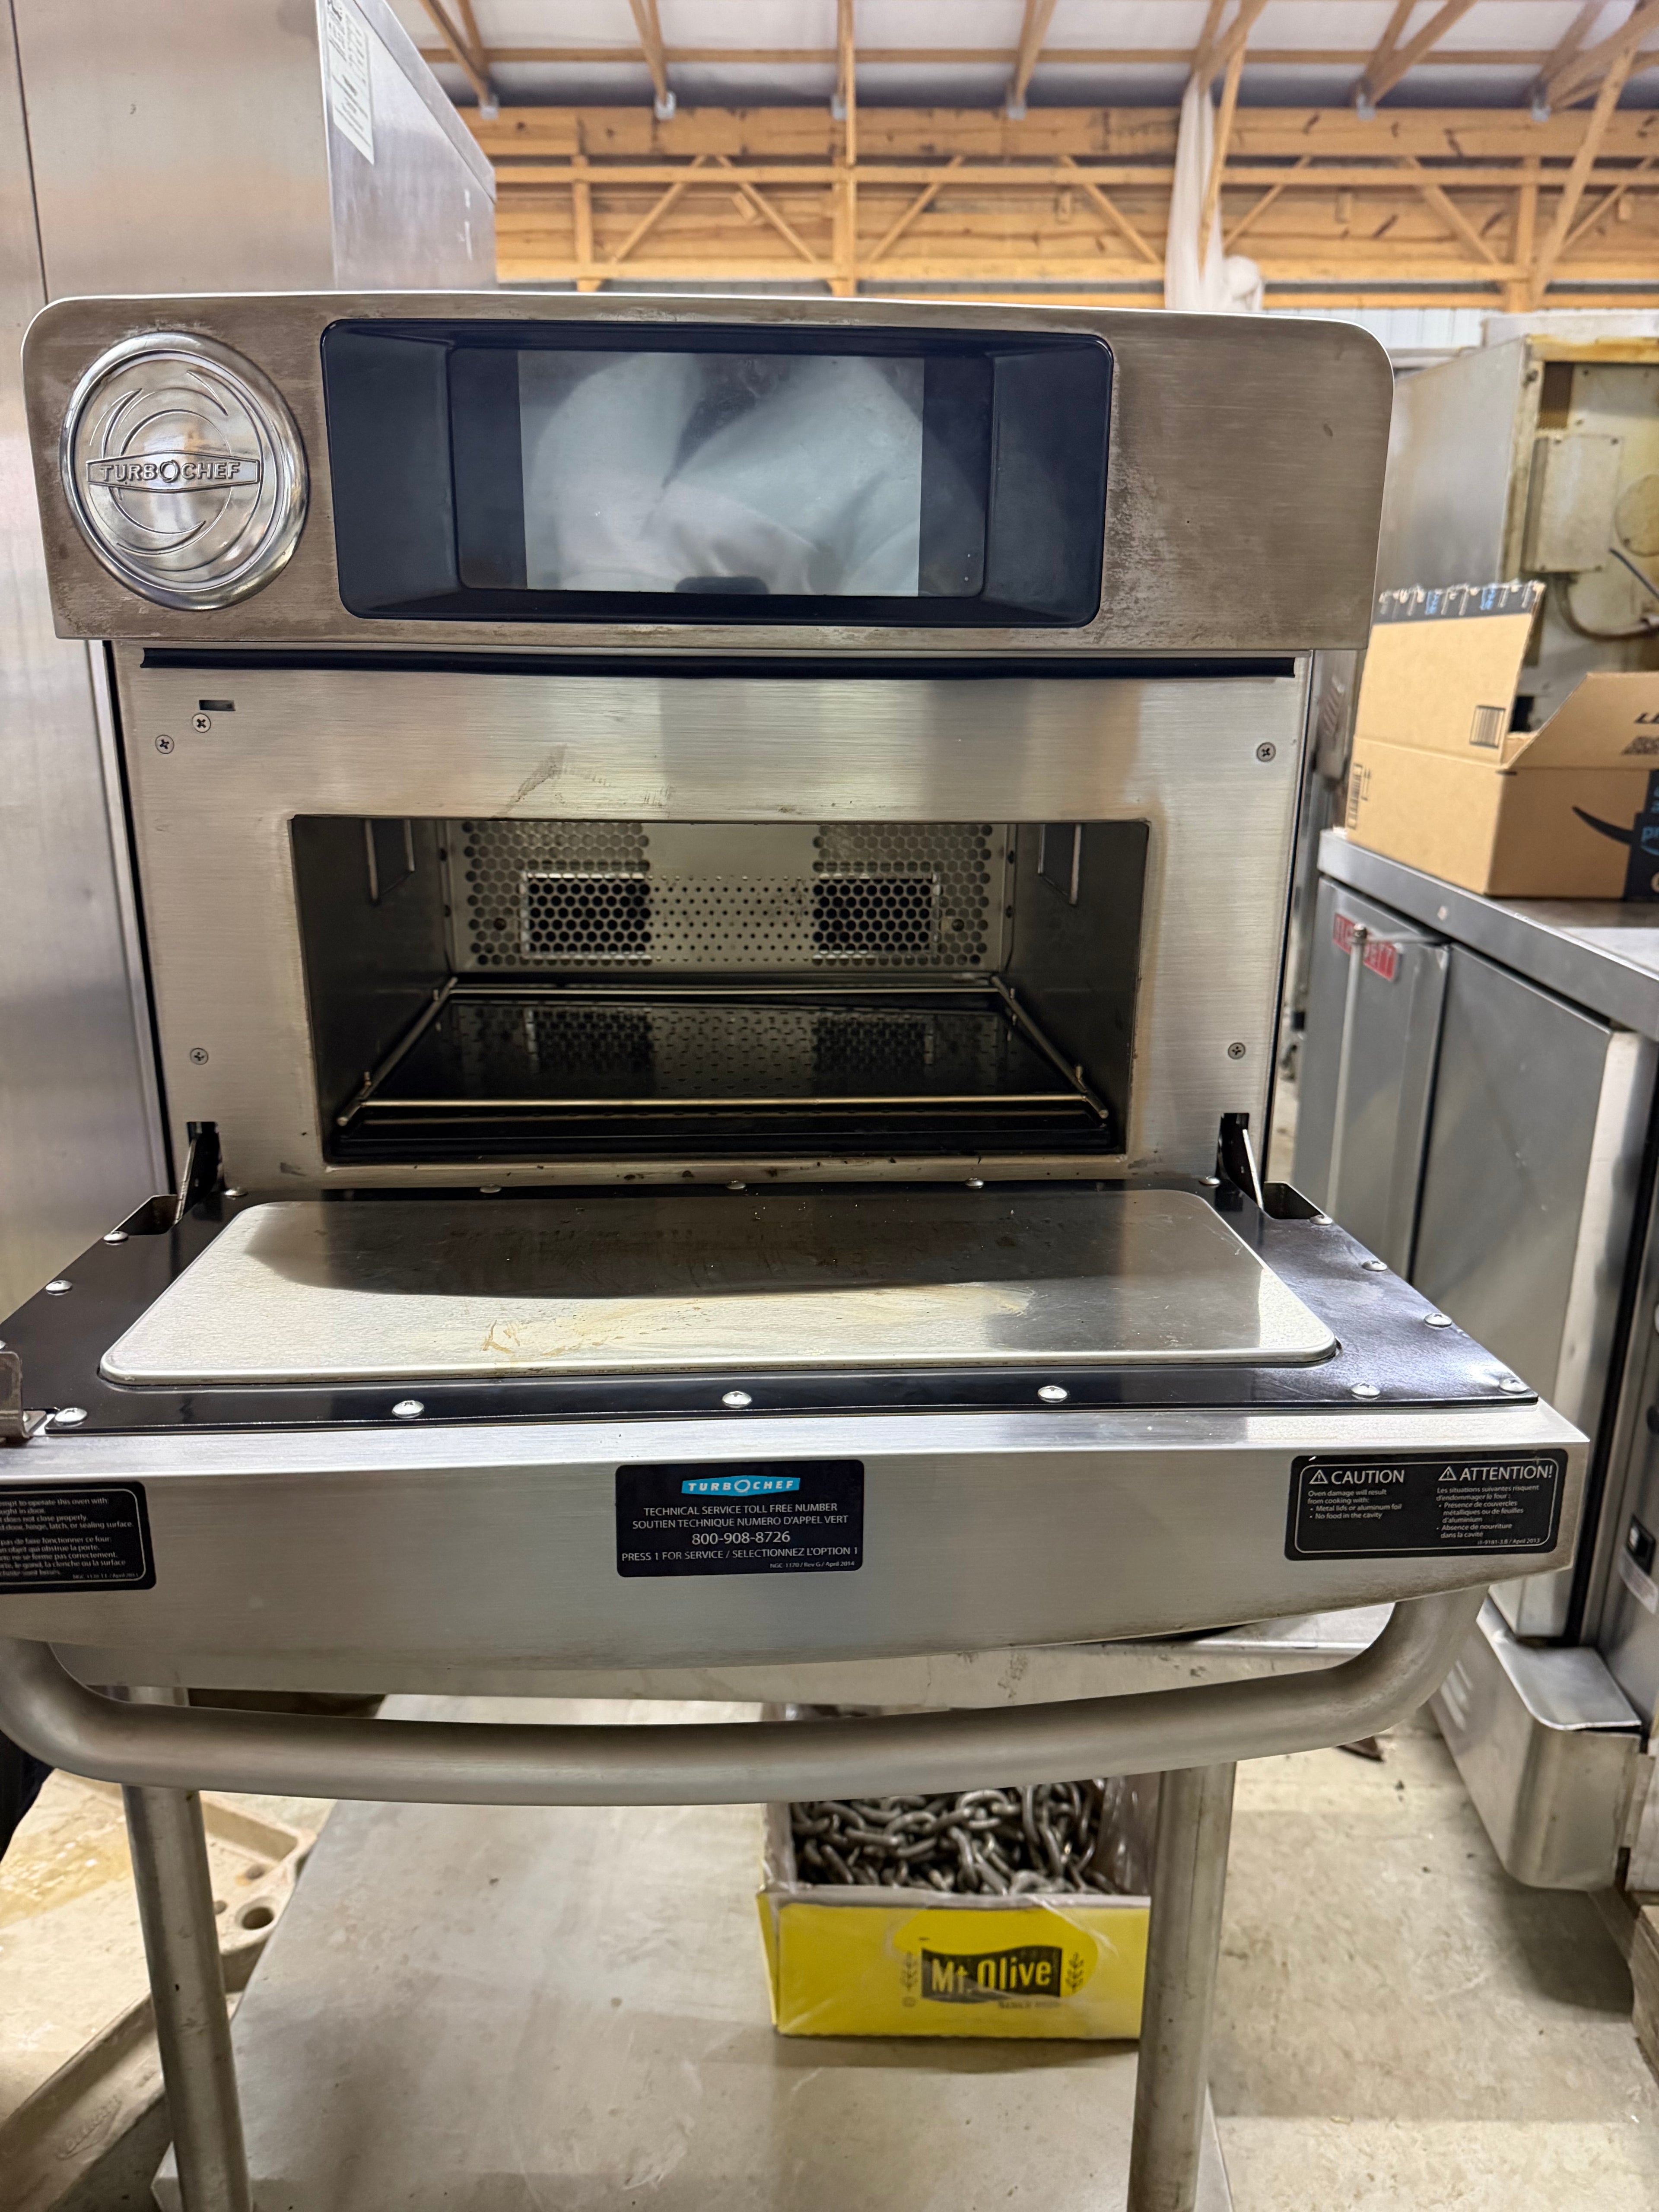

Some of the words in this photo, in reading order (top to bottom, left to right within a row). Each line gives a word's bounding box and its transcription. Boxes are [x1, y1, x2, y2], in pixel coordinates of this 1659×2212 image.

[99, 460, 241, 483] TURBOCHEF
[1331, 1470, 1405, 1484] CAUTION
[1459, 1465, 1553, 1481] ATTENTION!
[688, 1479, 794, 1493] TURBOCHEF
[644, 1506, 700, 1516] TECHNICAL
[702, 1506, 741, 1515] SERVICE
[744, 1505, 767, 1513] TOLL
[769, 1504, 793, 1513] FREE
[795, 1503, 837, 1512] NUMBER
[79, 1521, 105, 1529] sealing
[632, 1520, 676, 1529] SOUTIEN
[677, 1519, 734, 1528] TECHNIQUE
[737, 1517, 781, 1526] NUMERO
[783, 1516, 823, 1525] D'APPEL
[824, 1515, 849, 1523] VERT
[692, 1531, 790, 1545] 800-908-8726
[622, 1552, 652, 1561] PRESS
[662, 1552, 682, 1560] FOR
[684, 1551, 724, 1560] SERVICE
[725, 1551, 730, 1559] /
[732, 1548, 804, 1558] SELECTIONNEZ
[807, 1547, 850, 1556] L'OPTION
[931, 1958, 971, 1994] Mt.
[977, 1956, 1052, 1992] Olive
